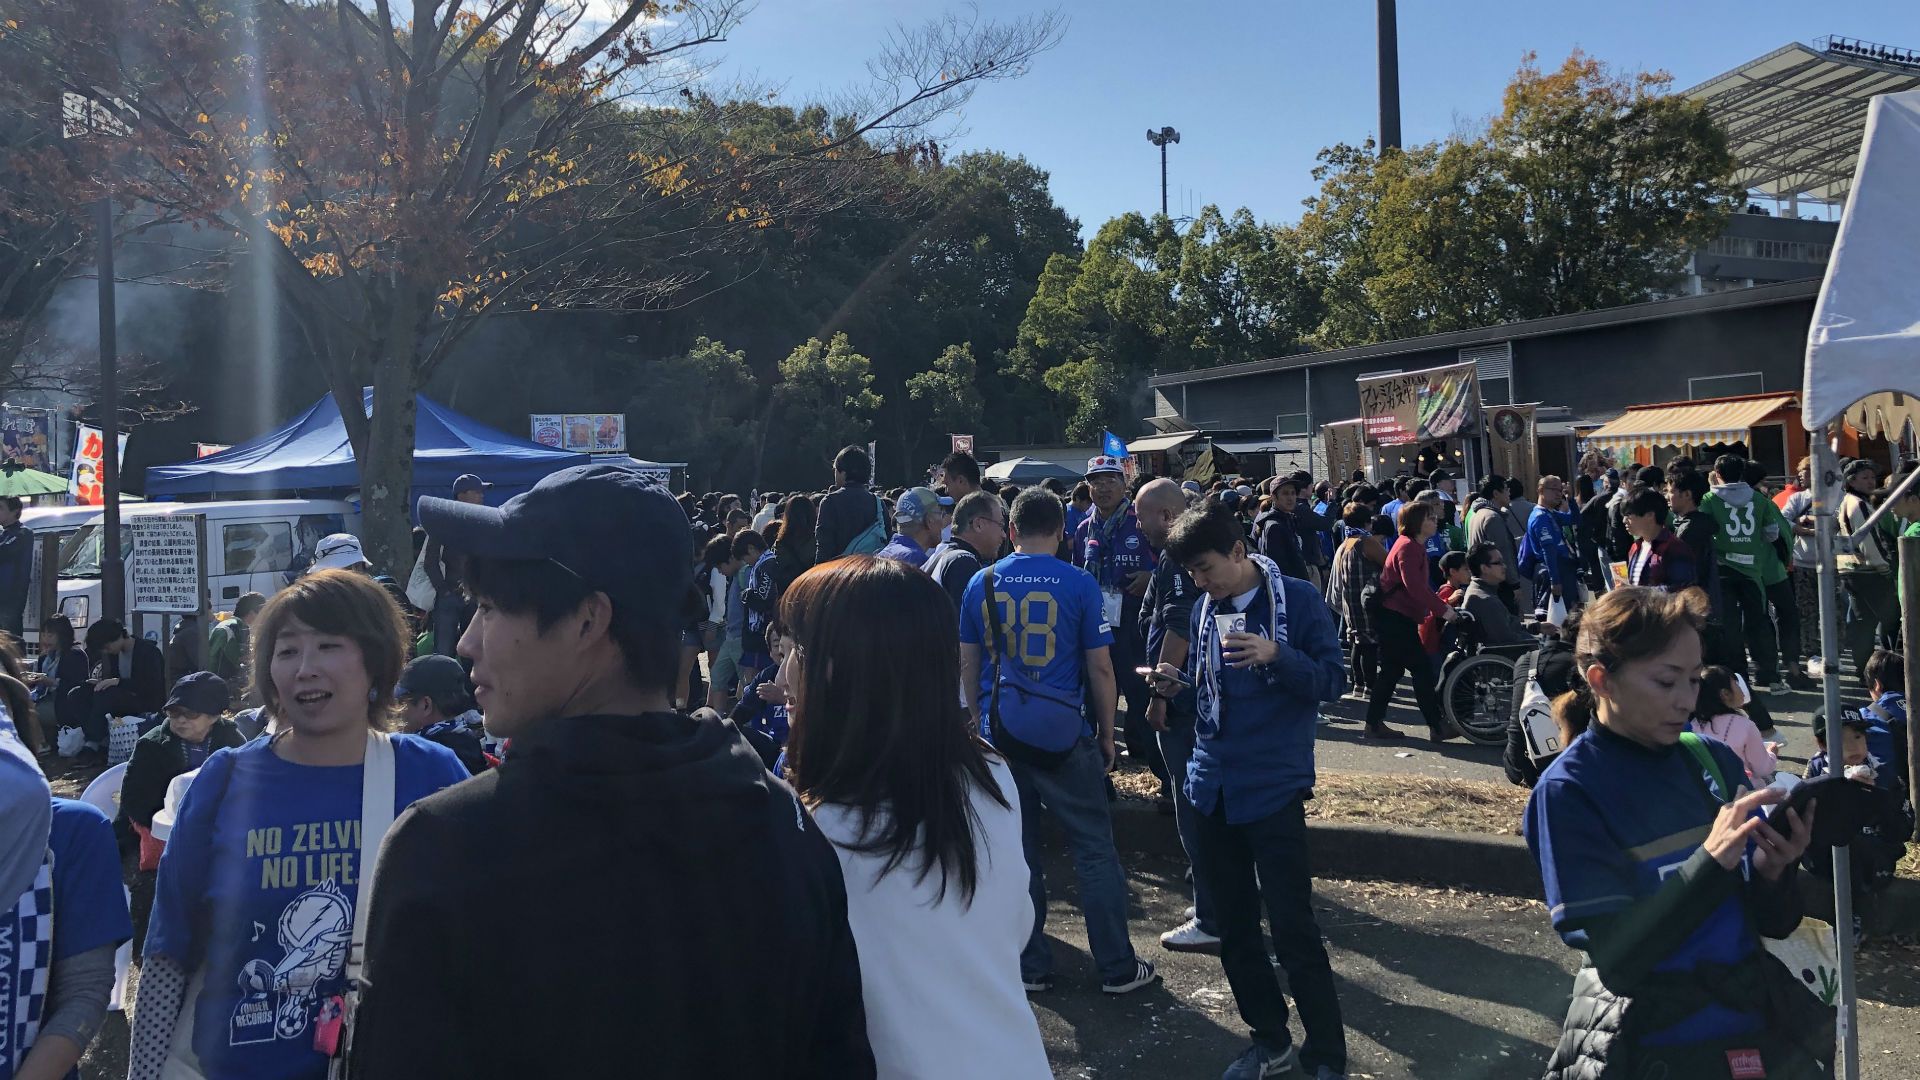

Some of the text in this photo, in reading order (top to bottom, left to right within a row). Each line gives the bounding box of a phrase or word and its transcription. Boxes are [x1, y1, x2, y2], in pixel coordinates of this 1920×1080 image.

[1361, 379, 1401, 404] プレミアム
[1724, 501, 1755, 536] 33
[981, 591, 1058, 667] 88
[246, 820, 362, 858] NO ZELVI
[261, 856, 298, 890] NO
[236, 1010, 273, 1028] RECORDS
